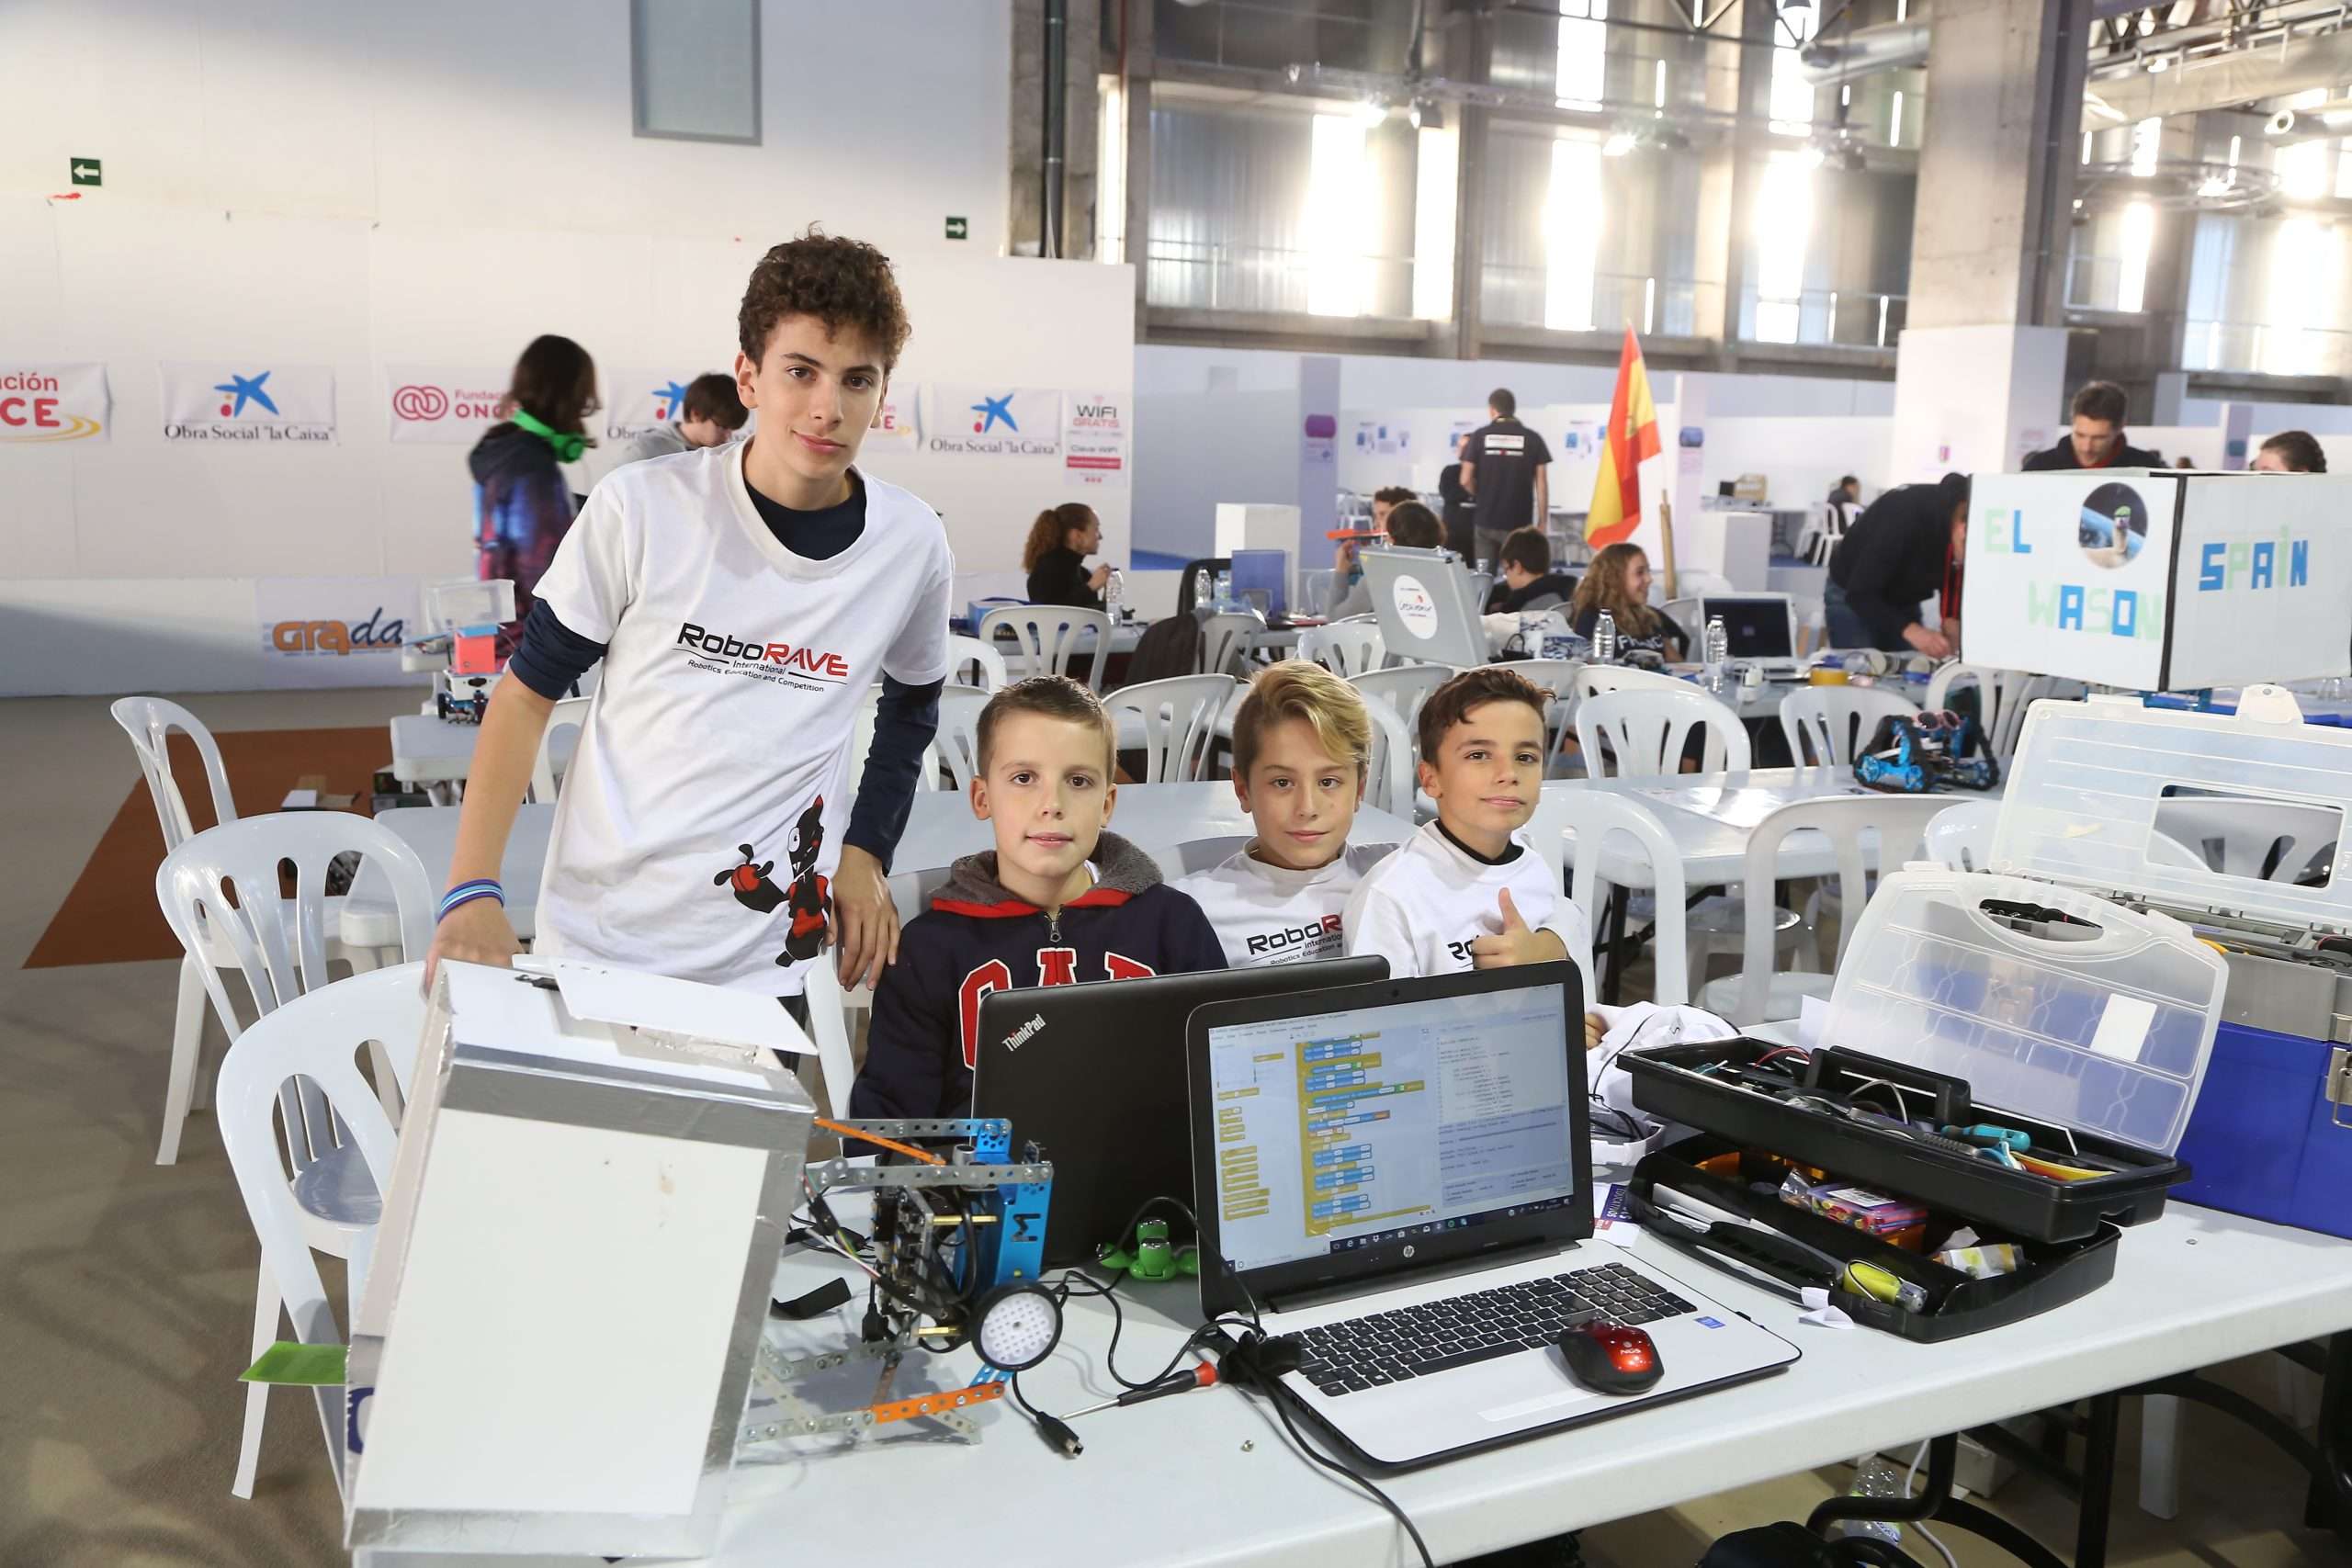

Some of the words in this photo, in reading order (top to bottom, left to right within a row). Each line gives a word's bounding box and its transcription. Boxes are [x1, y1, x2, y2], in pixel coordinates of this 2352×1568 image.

[164, 424, 208, 440] Obra
[212, 424, 259, 440] Social
[930, 439, 963, 452] Obra
[965, 439, 1001, 452] Social
[1984, 508, 2031, 553] EL
[2029, 581, 2163, 640] WASON
[677, 623, 848, 676] RoboRAVE
[733, 660, 786, 674] International
[688, 660, 721, 674] Robotics
[725, 669, 763, 679] Ecation
[763, 674, 775, 682] and
[777, 677, 824, 692] Competition
[1247, 914, 1342, 954] RoboR
[1305, 932, 1342, 948] Internatio
[1001, 1013, 1046, 1052] ThinkPad
